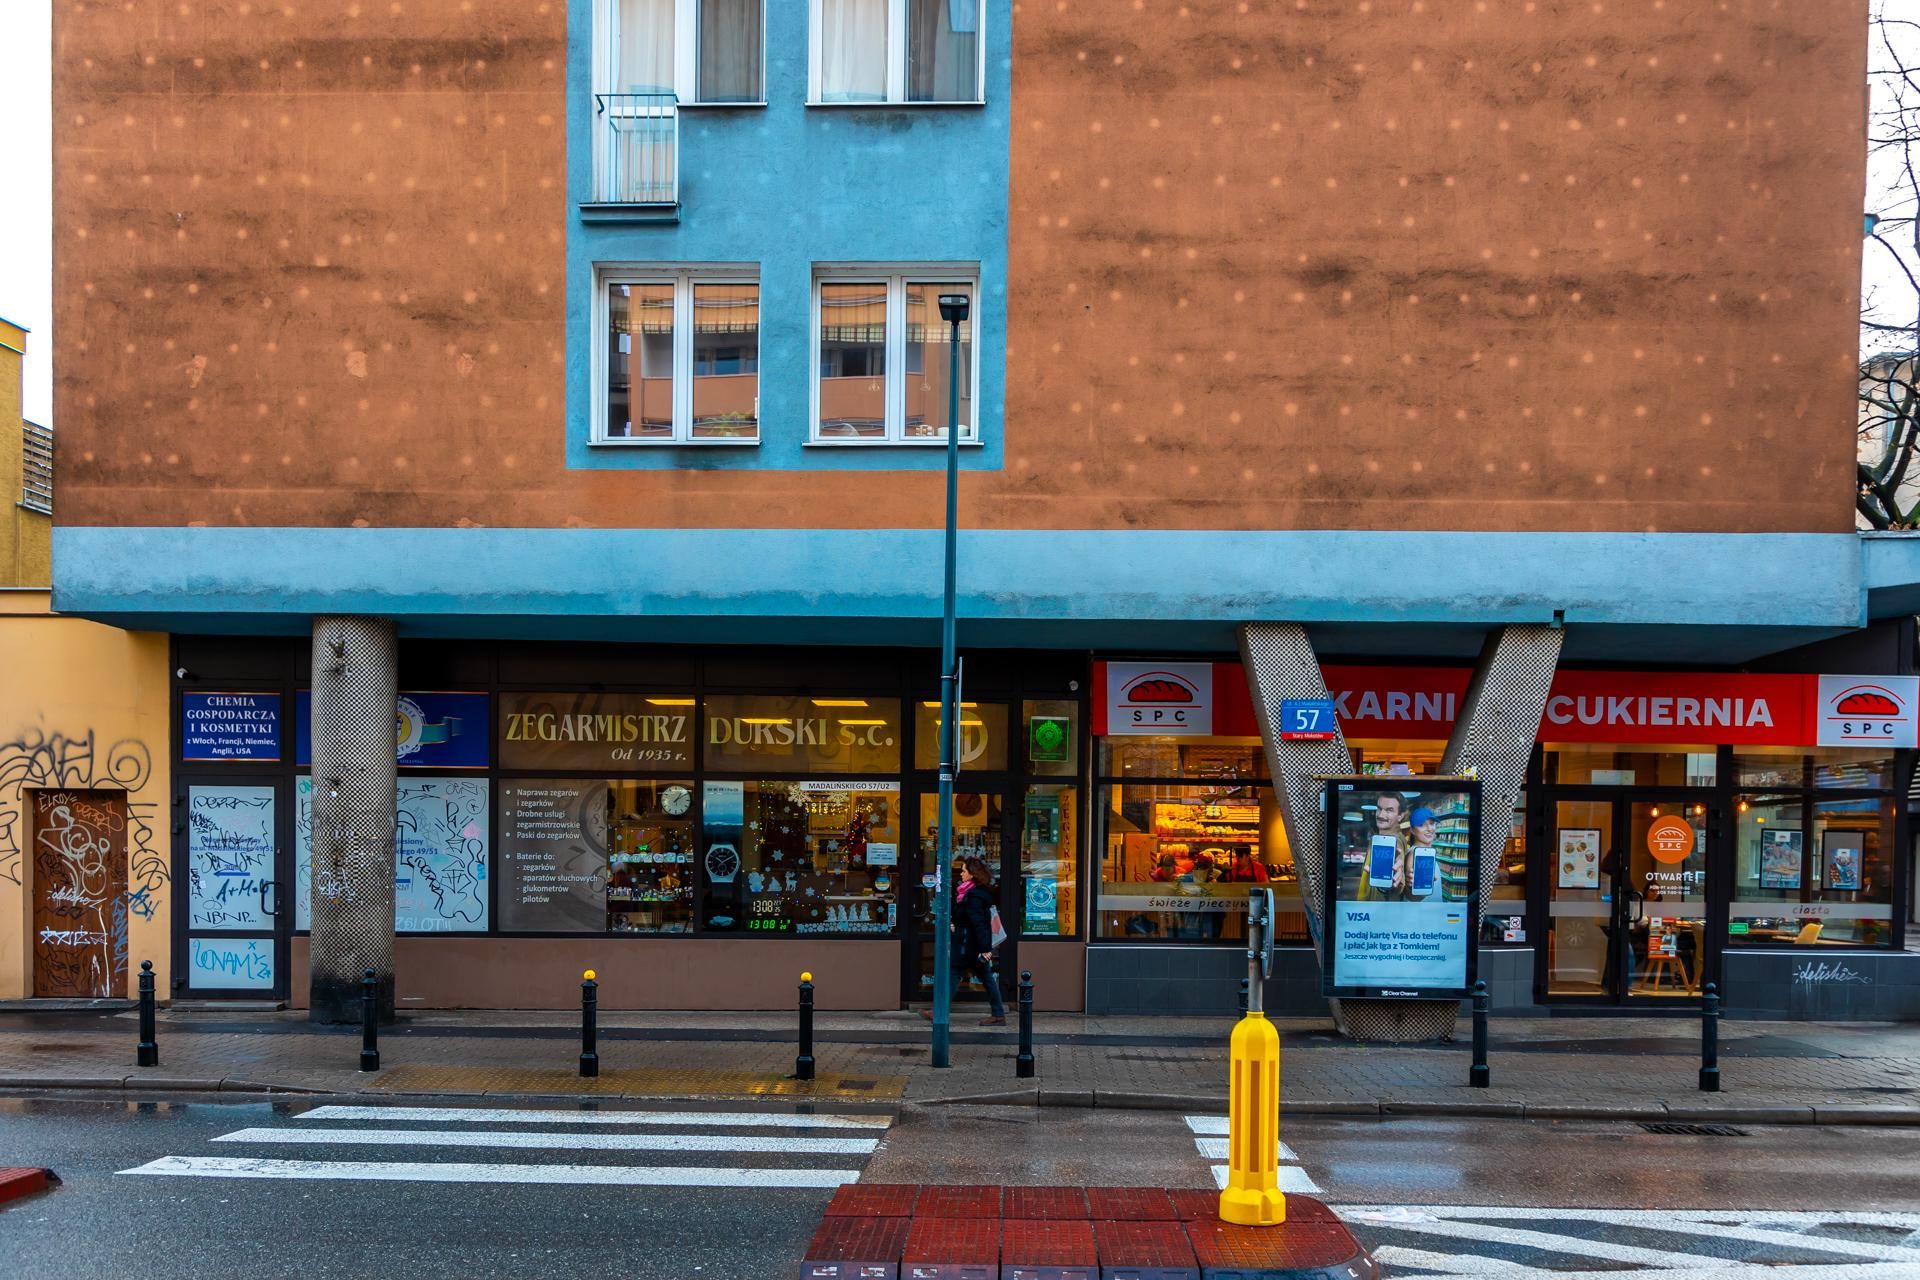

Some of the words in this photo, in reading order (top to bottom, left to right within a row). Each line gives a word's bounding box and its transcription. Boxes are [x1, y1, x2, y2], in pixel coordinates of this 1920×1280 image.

[207, 696, 256, 707] CHEMIA
[186, 709, 276, 720] GOSPODARCZA
[1546, 695, 1774, 727] CUKIERNIA
[1296, 709, 1320, 730] 57
[191, 723, 195, 732] I
[200, 723, 272, 733] KOSMETYKI
[506, 713, 687, 743] ZEGARMISTRZ
[710, 717, 827, 745] DURSKI
[192, 737, 217, 745] Włoch,
[218, 737, 244, 746] Francji,
[245, 737, 277, 746] Niemiec,
[211, 747, 235, 755] Anglii,
[610, 747, 633, 760] Od
[637, 749, 672, 760] 1935
[675, 751, 686, 760] r.
[516, 789, 549, 797] Naprawa
[550, 789, 579, 797] zegarów
[521, 799, 554, 808] zegarków
[516, 810, 543, 818] Drobne
[516, 821, 581, 830] zegarmistrzowskie
[516, 831, 535, 839] Paski
[536, 831, 546, 839] do
[547, 831, 580, 840] zegarków
[516, 852, 542, 860] Baterie
[543, 852, 555, 860] do:
[522, 863, 556, 872] zegarków
[522, 874, 556, 883] aparatów
[1645, 872, 1694, 881] OTWARTE
[522, 884, 569, 893] glukometrów
[522, 895, 550, 904] pilotów
[1198, 899, 1250, 910] pieczyw
[1791, 904, 1830, 915] ciasta
[1346, 912, 1370, 921] VISA
[1344, 931, 1369, 940] Dodaj
[1369, 931, 1391, 941] kartę
[1391, 931, 1409, 939] Visa
[1409, 932, 1421, 940] do
[1422, 932, 1458, 941] telefonu
[1347, 942, 1366, 951] płać
[1366, 942, 1379, 951] jak
[1398, 942, 1440, 951] Tomkiem!
[1369, 953, 1402, 962] wygodniej
[1405, 954, 1448, 962] bezpieczniej.
